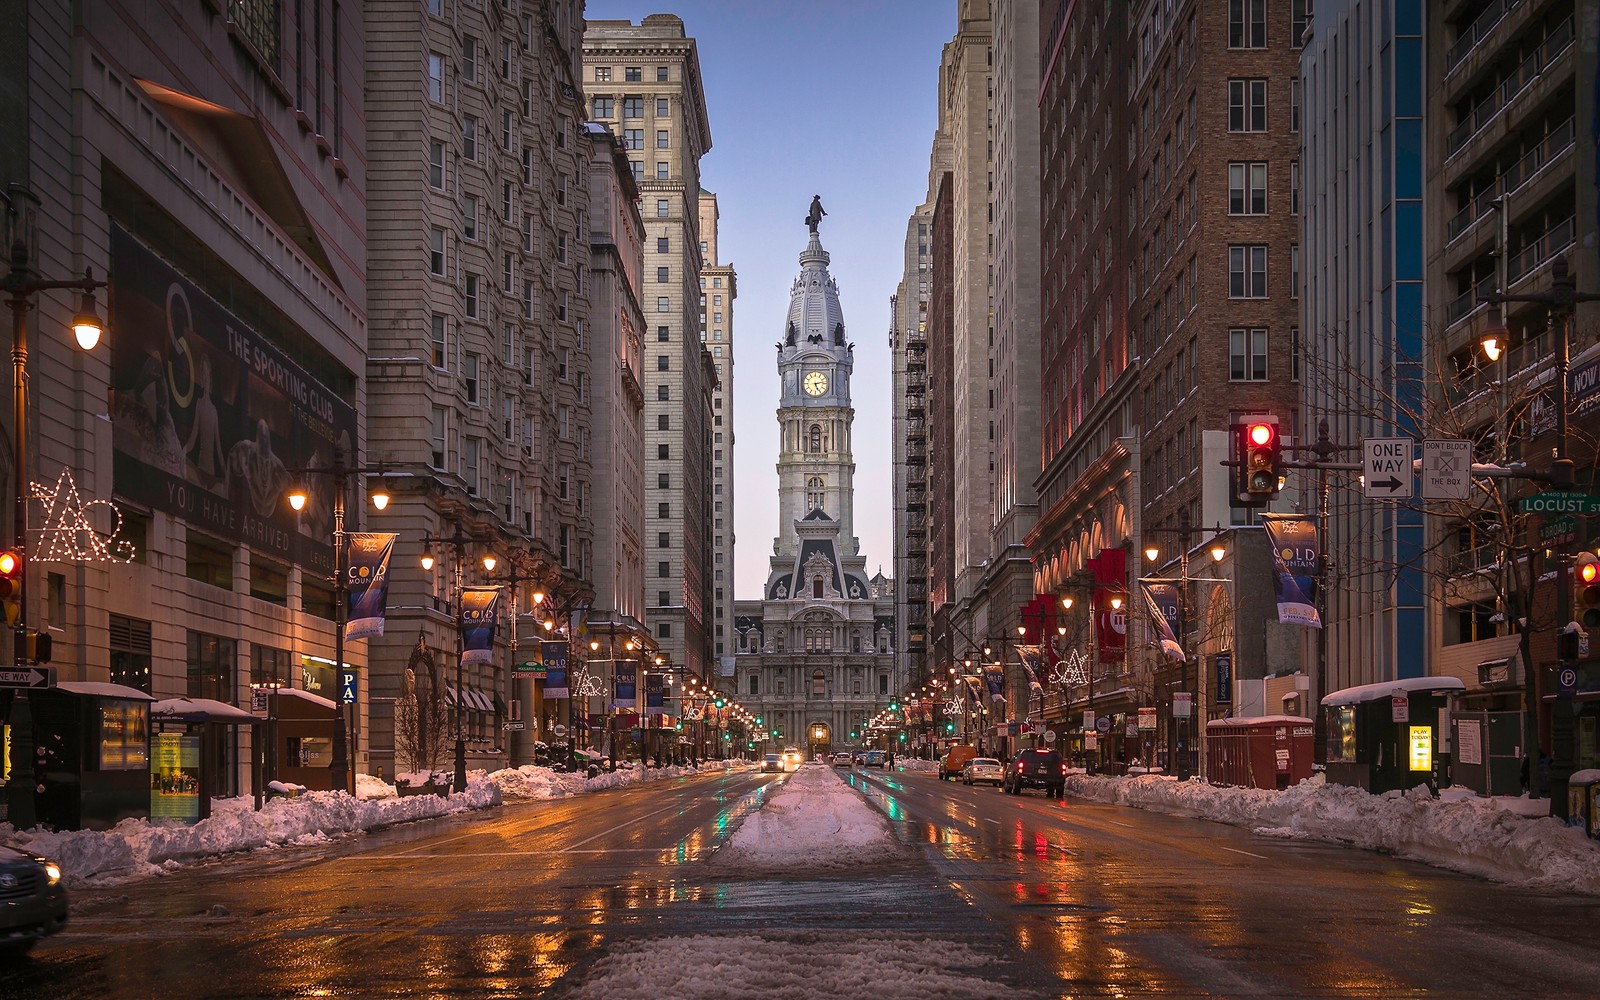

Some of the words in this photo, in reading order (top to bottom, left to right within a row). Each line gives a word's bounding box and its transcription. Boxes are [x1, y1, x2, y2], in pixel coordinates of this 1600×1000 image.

[225, 323, 251, 365] THE
[254, 346, 307, 405] SPORTING
[310, 388, 334, 424] CLUB
[1573, 364, 1598, 393] NOW
[1373, 443, 1403, 457] ONE
[1446, 442, 1468, 450] BLOCK
[1372, 459, 1404, 473] WAY
[1431, 478, 1444, 486] THE
[1447, 477, 1461, 486] BOX
[1525, 499, 1585, 512] LOCUST
[167, 481, 194, 513] YOU
[203, 496, 236, 530] HAVE
[242, 514, 289, 551] ARRIVED
[1545, 521, 1567, 538] BROAD
[310, 549, 330, 569] LEVEL
[1273, 547, 1315, 561] COLD
[1275, 559, 1315, 568] MUNTAIN
[543, 659, 566, 667] COLD
[0, 673, 10, 681] NE
[12, 673, 30, 681] WAY
[298, 749, 320, 758] bliss
